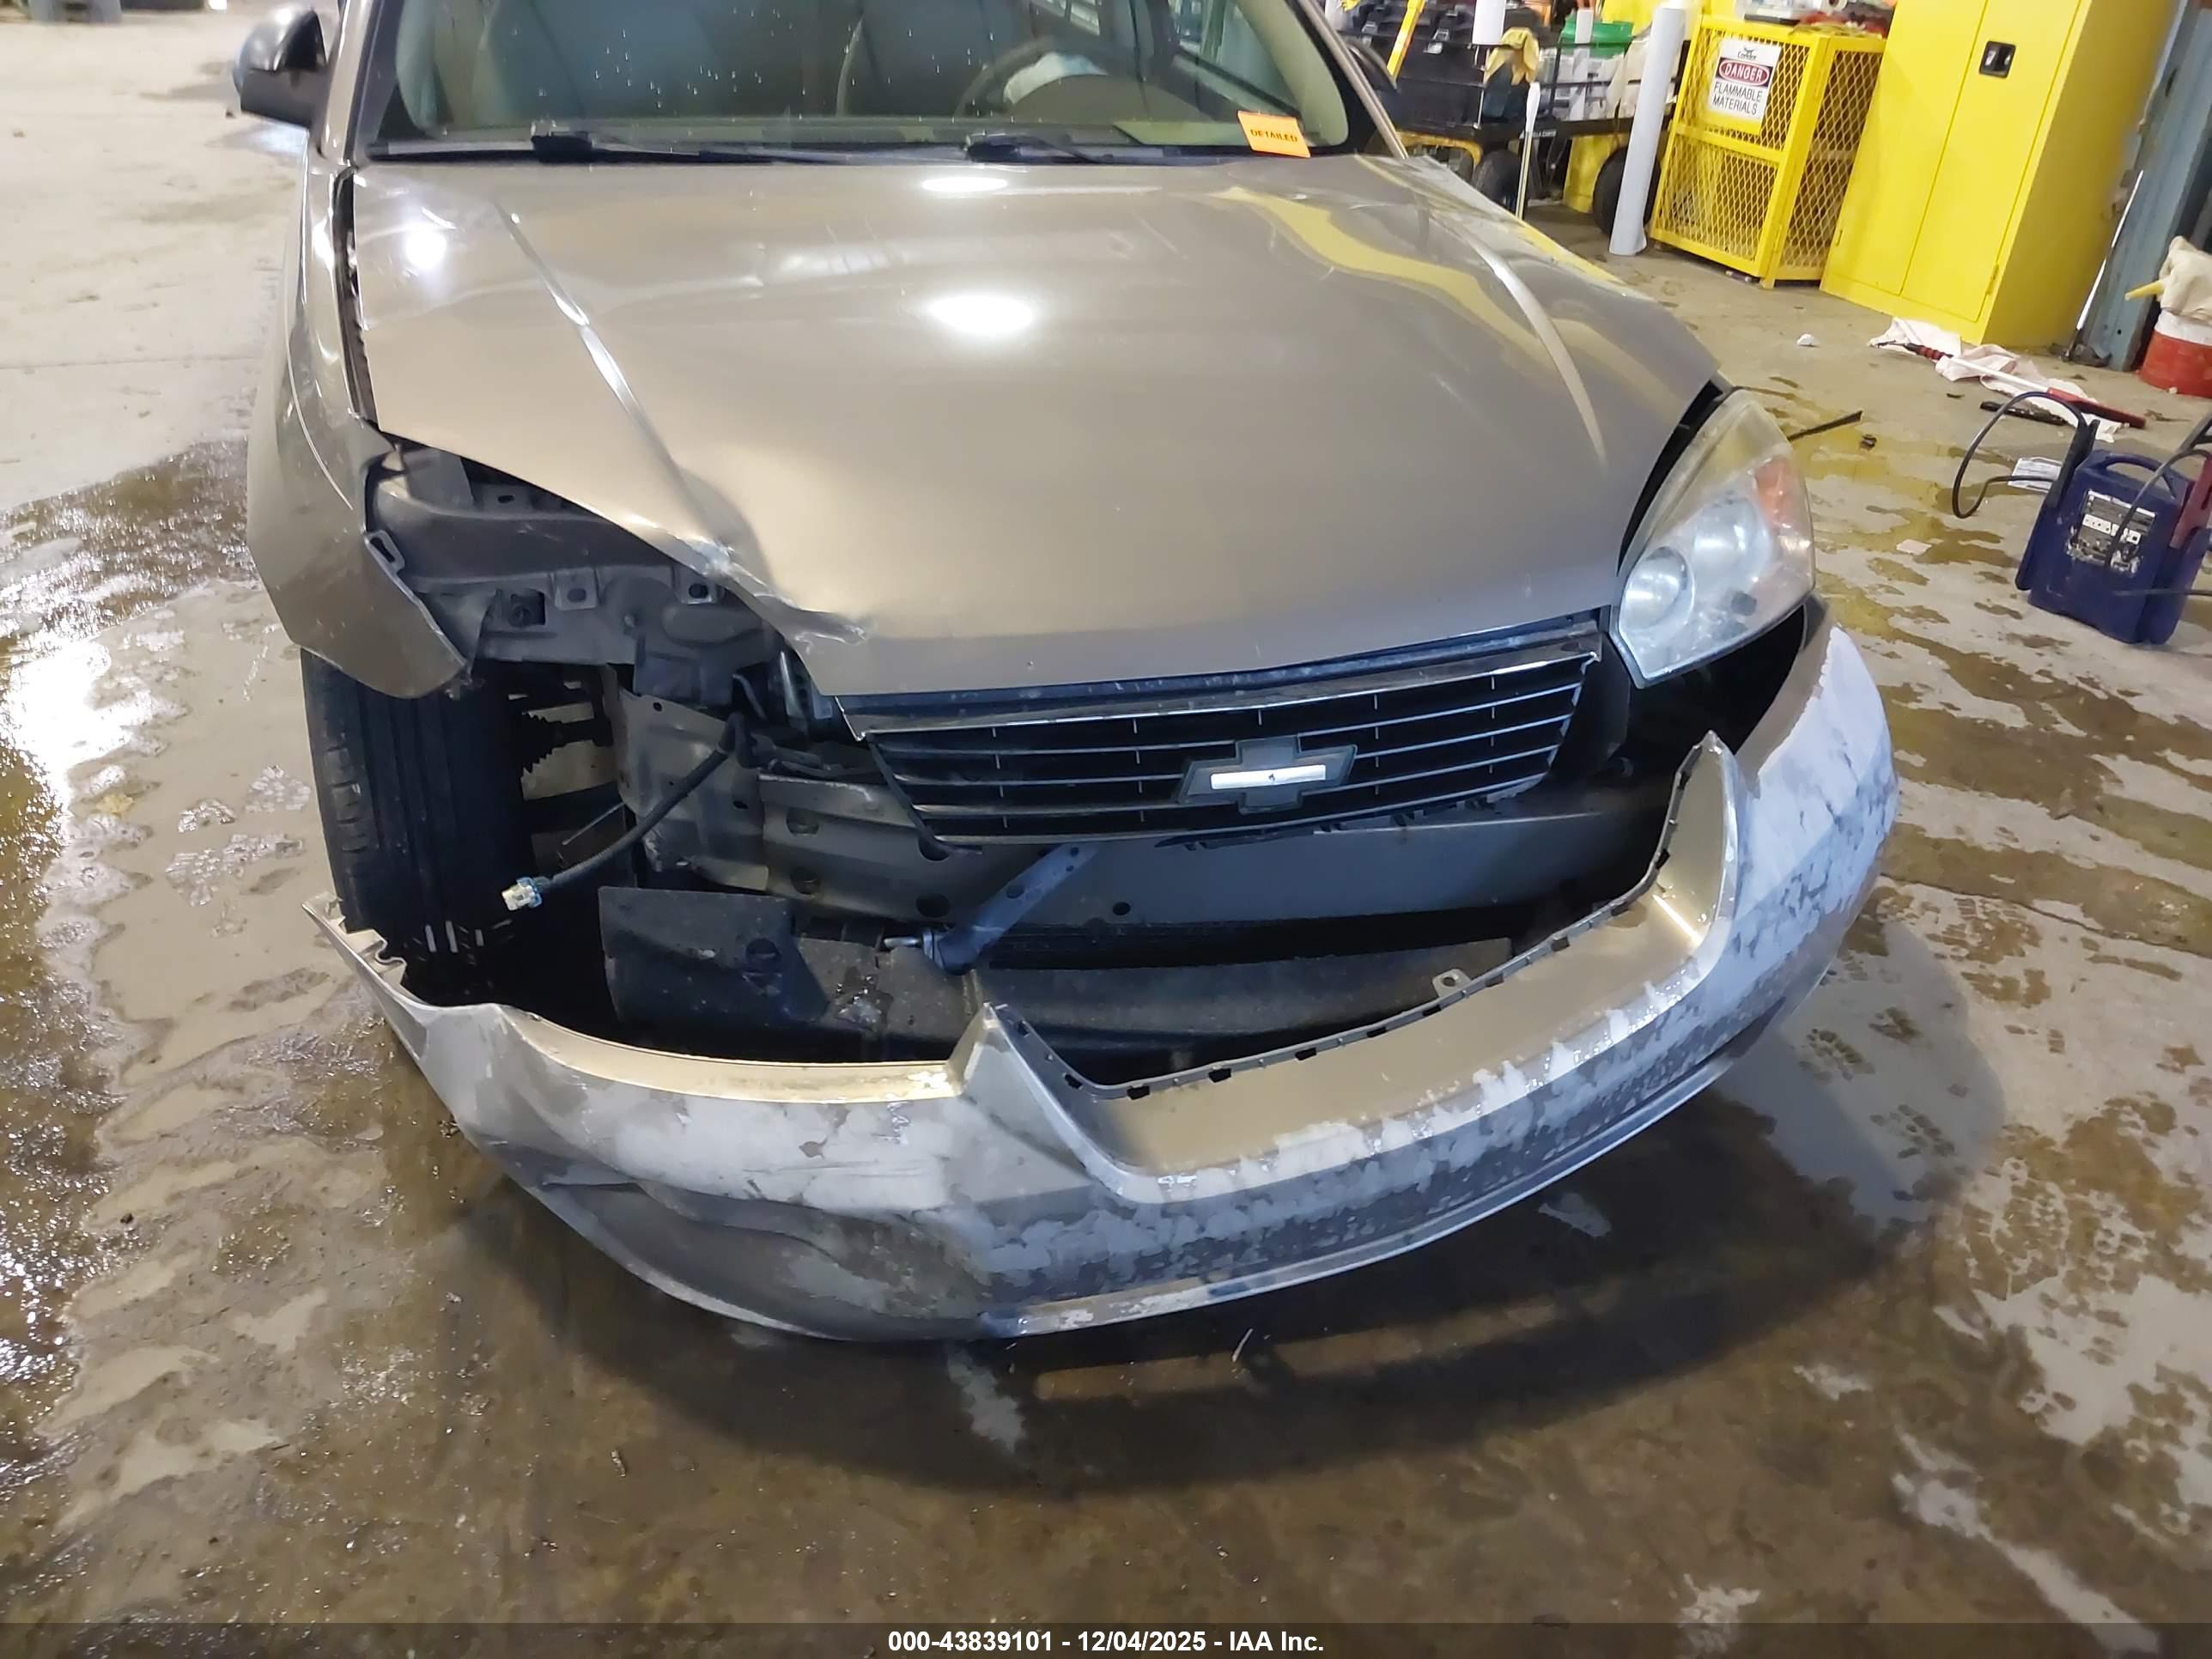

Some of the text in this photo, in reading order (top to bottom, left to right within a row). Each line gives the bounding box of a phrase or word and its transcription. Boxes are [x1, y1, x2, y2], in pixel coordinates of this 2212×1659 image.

[1725, 64, 1762, 82] DANGER
[1715, 82, 1762, 101] FLAMMABLE
[1714, 95, 1757, 114] MATERIALS
[1250, 130, 1297, 142] DETAILED
